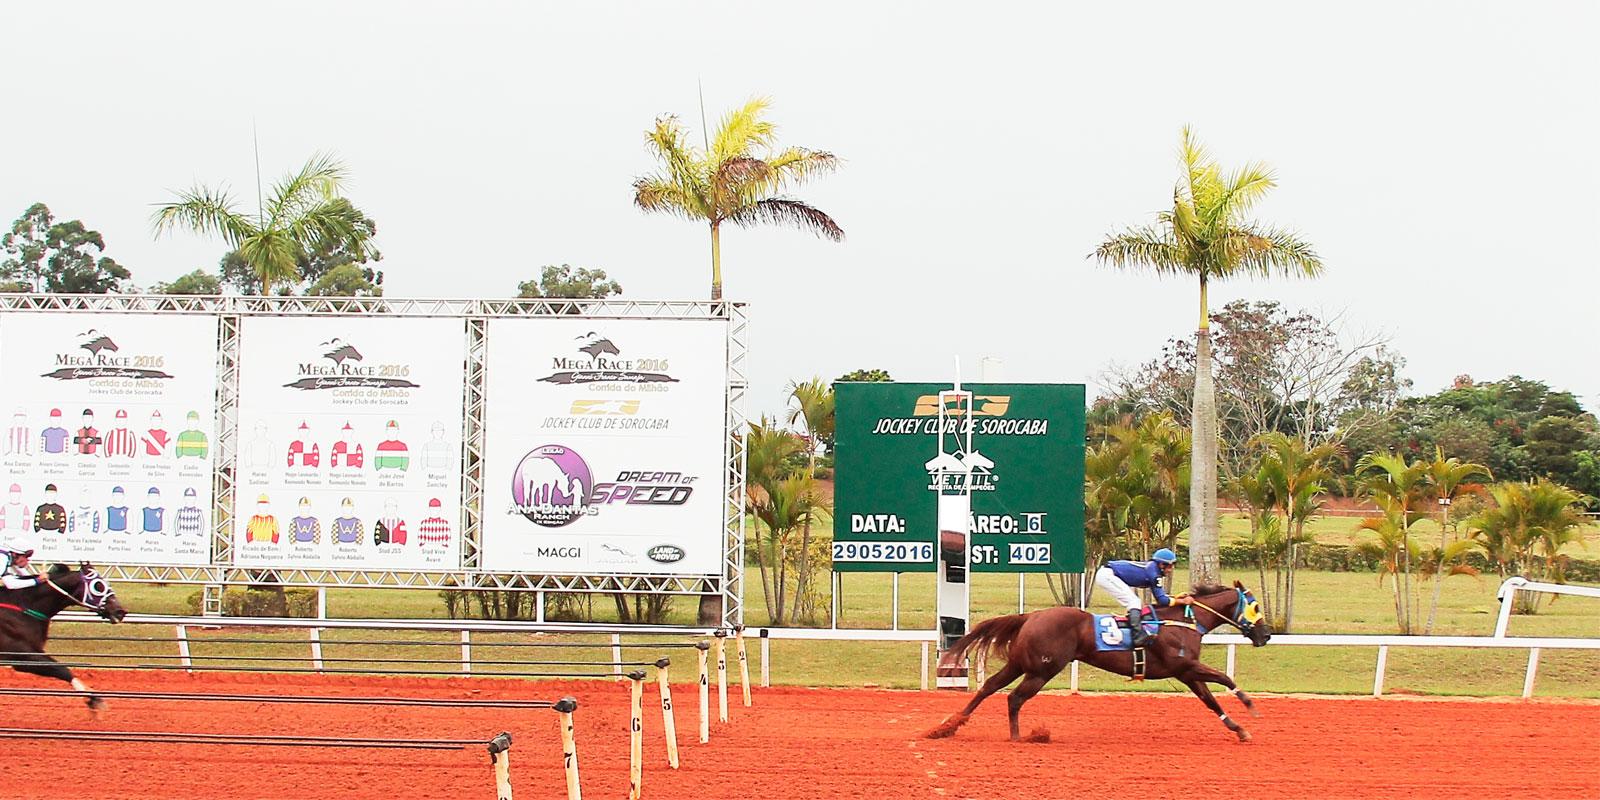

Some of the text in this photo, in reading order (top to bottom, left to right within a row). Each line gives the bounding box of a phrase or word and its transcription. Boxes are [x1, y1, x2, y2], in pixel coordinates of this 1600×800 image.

[55, 354, 164, 367] MEGA RACE 2016
[552, 357, 669, 371] MEGA RACE 2016
[297, 364, 410, 377] MEGA RACE 2016
[88, 379, 164, 388] Corrida do Milhão
[588, 383, 669, 393] Corrida do Milhão
[88, 388, 109, 396] Jockey
[332, 389, 410, 398] Corrida do Milhão
[332, 399, 353, 407] Jockey
[541, 417, 669, 430] JOCKEY CLUB DE SOROCABA
[873, 418, 1048, 435] JOCKEY CLUB DE SOROCABA
[616, 471, 699, 484] DREAM OF
[590, 482, 693, 505] SPEED
[507, 503, 599, 515] ANA DANTAS
[851, 514, 905, 533] DATA:
[968, 510, 1040, 534] ÁREO: 6
[537, 547, 581, 559] MAGGI
[655, 553, 680, 561] ROVER
[971, 545, 1049, 564] ST: 402
[1100, 616, 1124, 646] 3
[738, 650, 746, 661] 2
[718, 660, 725, 671] 3
[699, 673, 707, 686] 4
[663, 698, 672, 711] 5
[632, 717, 641, 732] 6
[563, 752, 573, 769] 7
